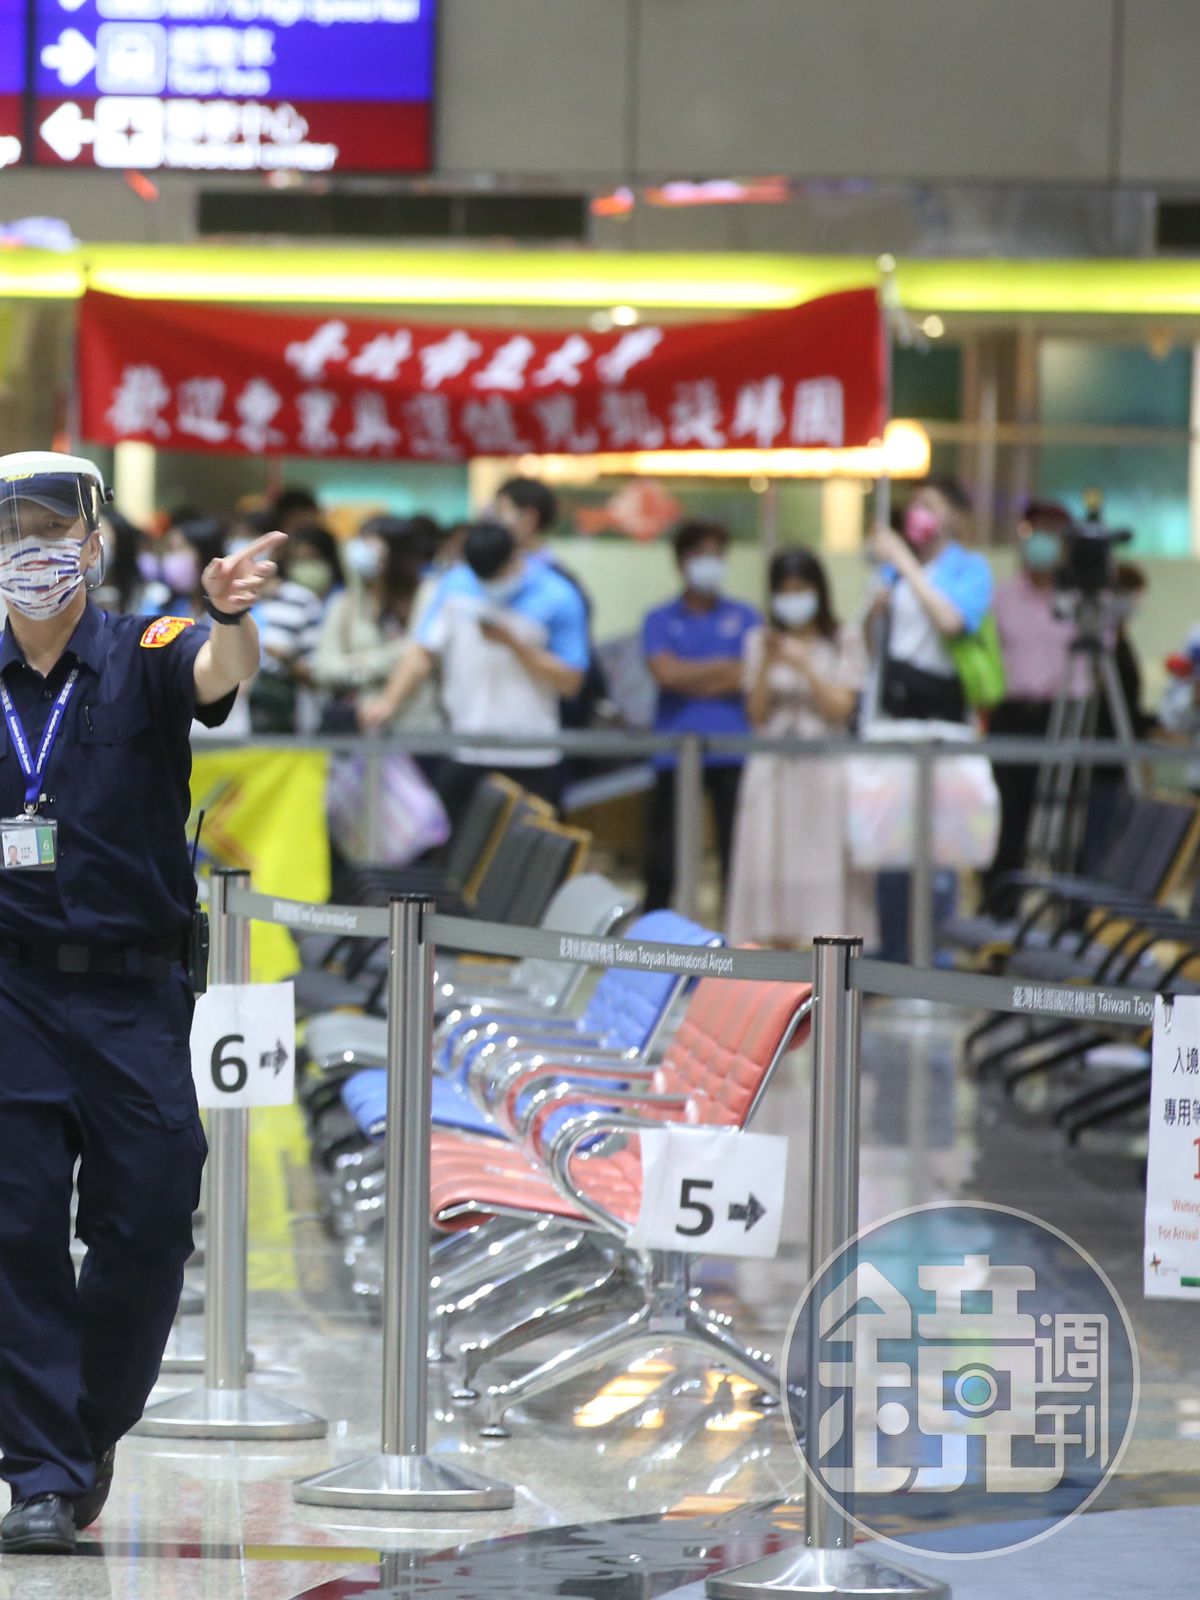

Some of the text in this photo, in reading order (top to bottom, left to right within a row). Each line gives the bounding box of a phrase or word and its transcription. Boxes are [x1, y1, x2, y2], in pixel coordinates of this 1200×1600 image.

[615, 944, 733, 975] Taiwan Taoyuan International Airport
[1098, 992, 1131, 1014] Taiwan
[210, 1034, 248, 1093] 6
[1173, 1046, 1199, 1075] 入境
[675, 1179, 714, 1236] 5
